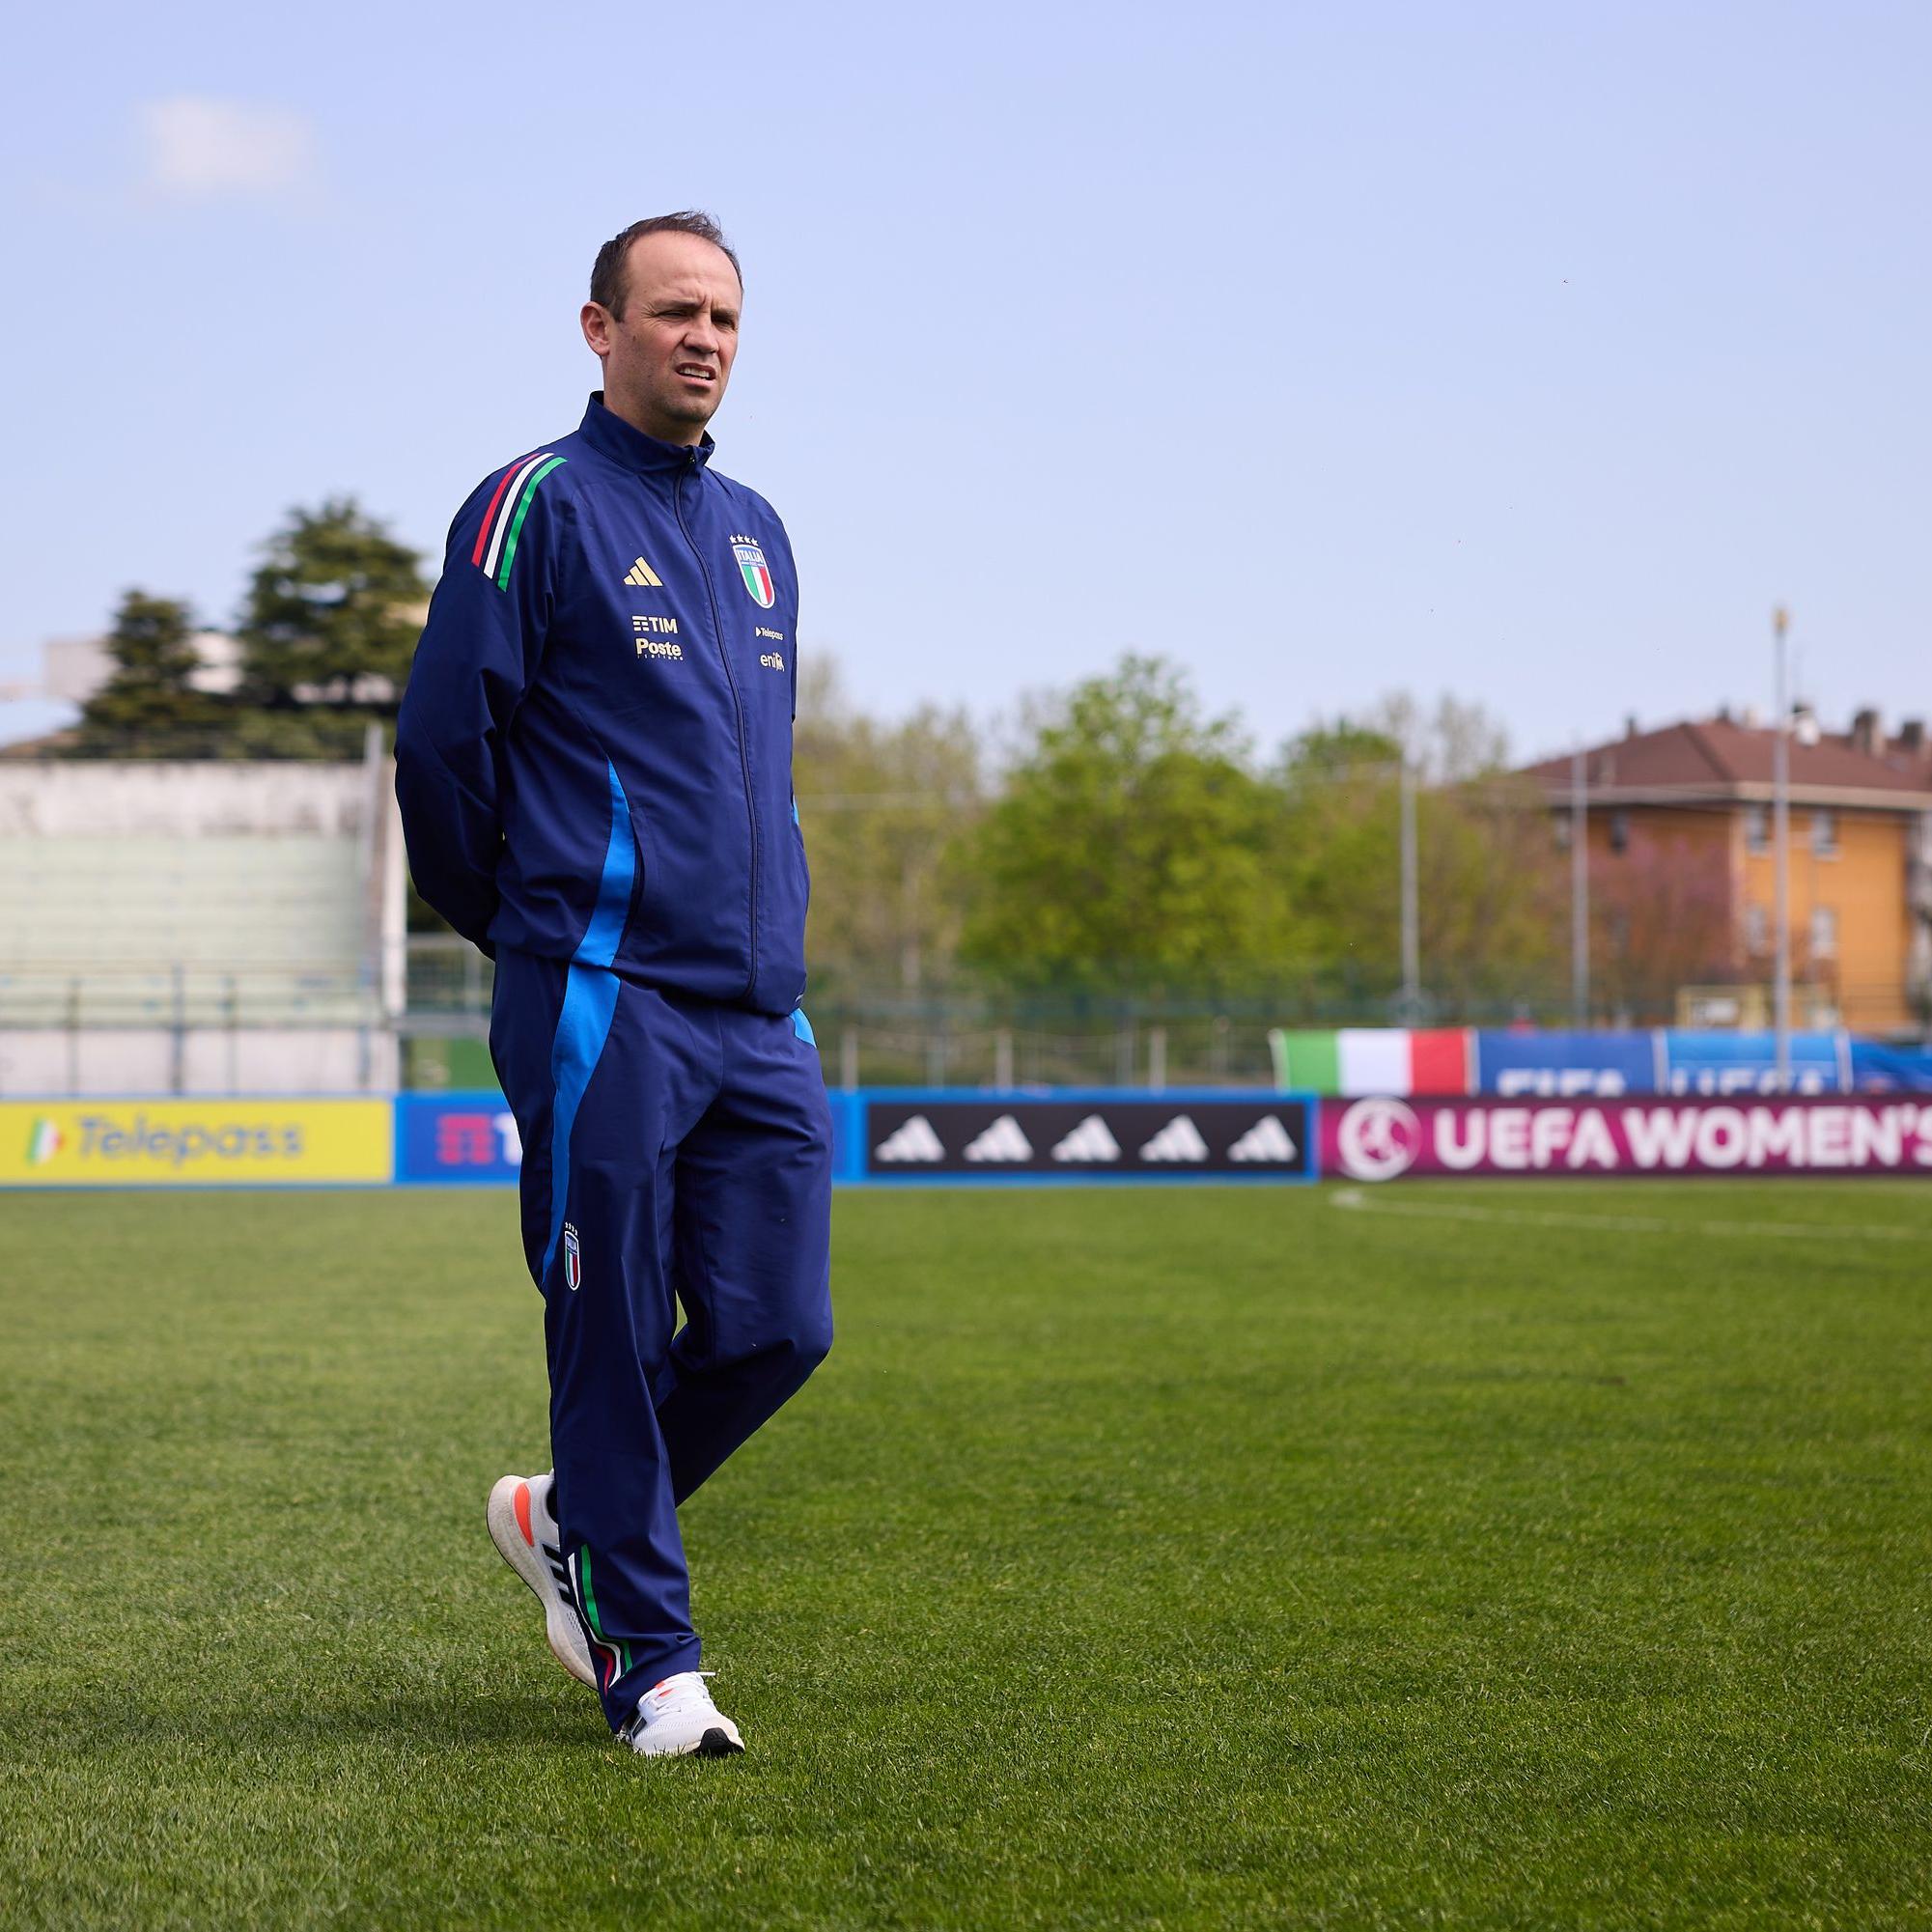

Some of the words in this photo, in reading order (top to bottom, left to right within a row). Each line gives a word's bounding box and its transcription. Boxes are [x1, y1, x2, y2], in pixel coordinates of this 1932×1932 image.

[648, 616, 678, 633] TIM
[760, 627, 783, 641] Telepass
[635, 637, 682, 656] Poste
[760, 652, 776, 668] eni
[77, 1113, 304, 1166] Telepass
[1433, 1106, 1620, 1170] UEFA
